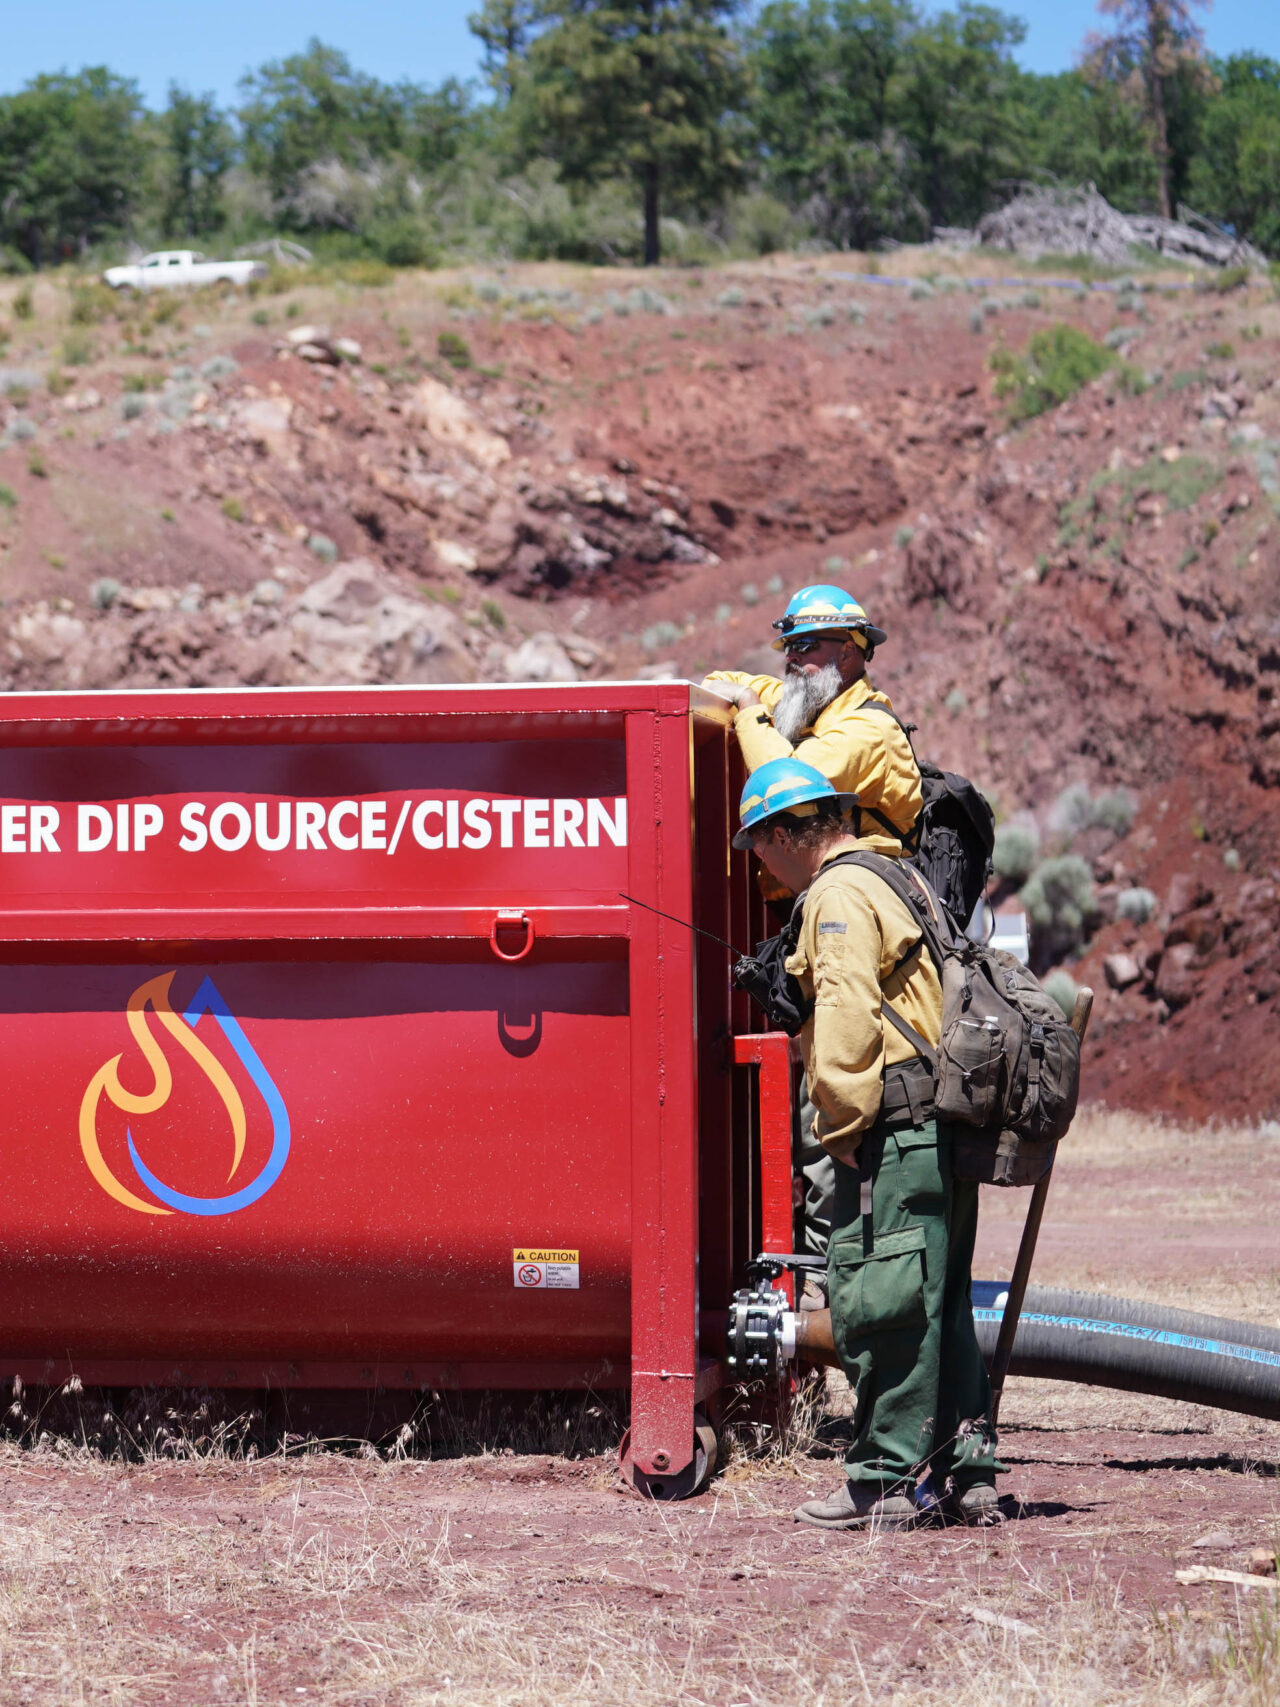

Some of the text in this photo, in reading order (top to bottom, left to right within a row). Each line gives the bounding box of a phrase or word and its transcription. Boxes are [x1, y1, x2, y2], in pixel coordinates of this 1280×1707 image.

[78, 803, 164, 852] DIP
[179, 797, 627, 855] SOURCE/CISTERN
[529, 1252, 576, 1262] CAUTION
